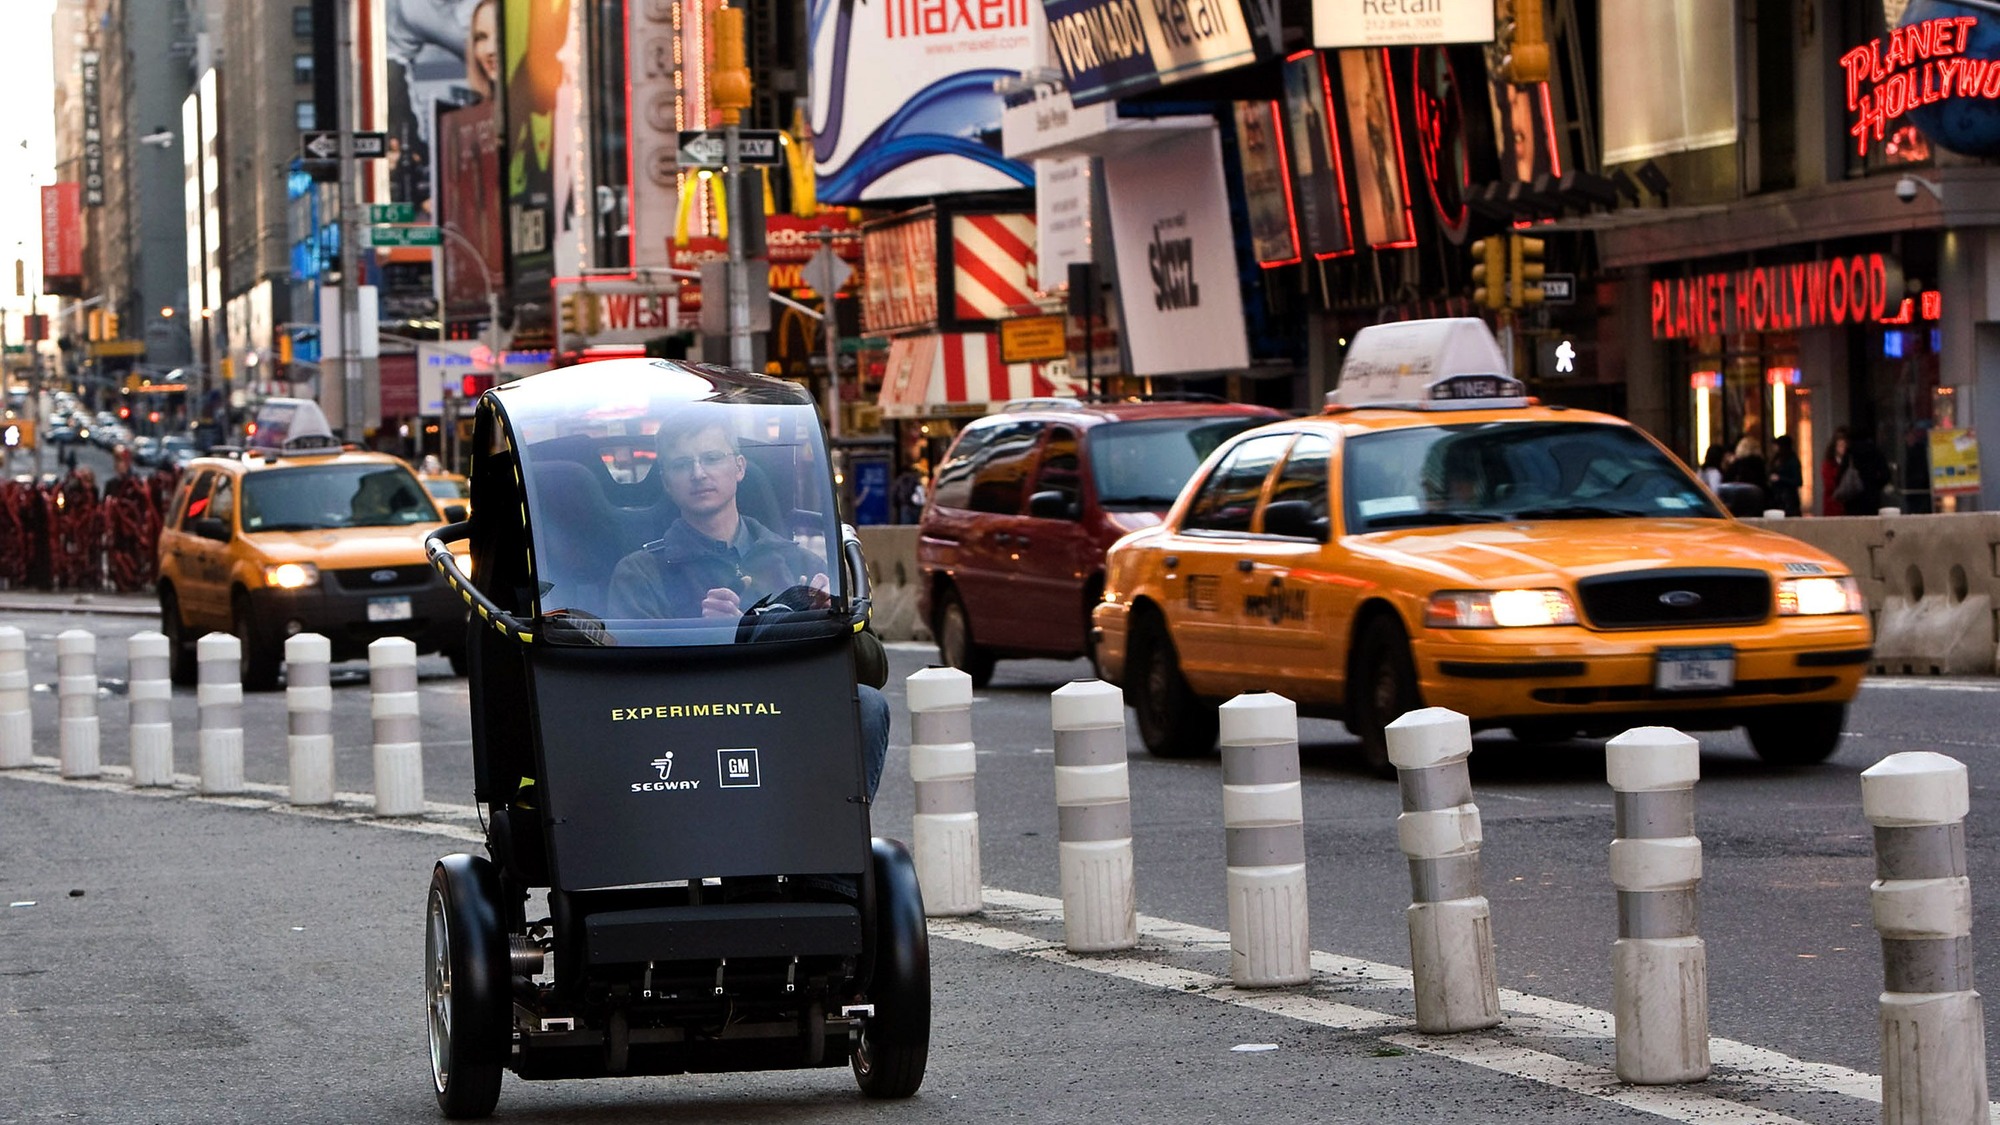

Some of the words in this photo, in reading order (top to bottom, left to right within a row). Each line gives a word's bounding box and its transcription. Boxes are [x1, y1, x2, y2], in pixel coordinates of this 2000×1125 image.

[1050, 0, 1145, 82] VORNADO
[1840, 16, 1978, 112] PLANET
[1652, 274, 1728, 339] PLANET
[1736, 253, 1887, 331] HOLLYWOOD
[611, 702, 782, 721] EXPERIMENTAL
[630, 780, 700, 793] SEGWAY
[728, 758, 749, 774] GM
